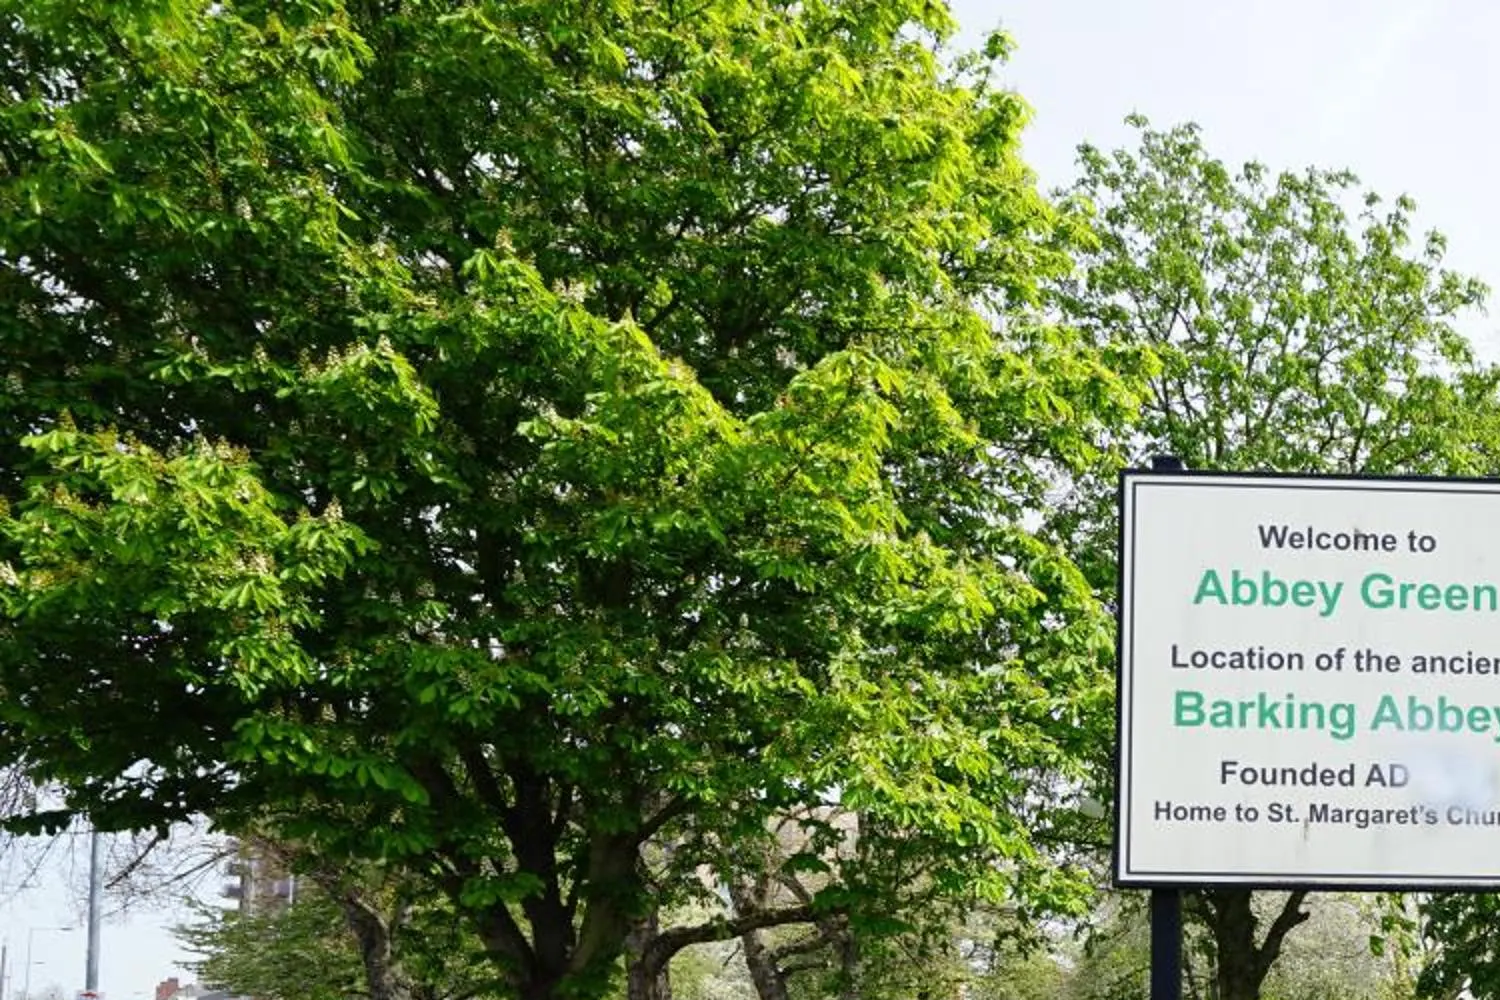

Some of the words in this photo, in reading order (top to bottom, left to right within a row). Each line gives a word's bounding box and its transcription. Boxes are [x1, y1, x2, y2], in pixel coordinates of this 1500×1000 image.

[1258, 525, 1397, 552] Welcome
[1408, 530, 1437, 552] to
[1193, 568, 1344, 617] Abbey
[1360, 572, 1498, 611] Green
[1171, 644, 1304, 671] Location
[1315, 648, 1347, 671] of
[1354, 649, 1400, 673] the
[1174, 690, 1356, 740] Barking
[1220, 761, 1355, 786] Founded
[1365, 764, 1410, 787] AD
[1154, 800, 1227, 821] Home
[1235, 803, 1259, 822] to
[1268, 803, 1300, 823] St.
[1309, 804, 1438, 828] Margaret's
